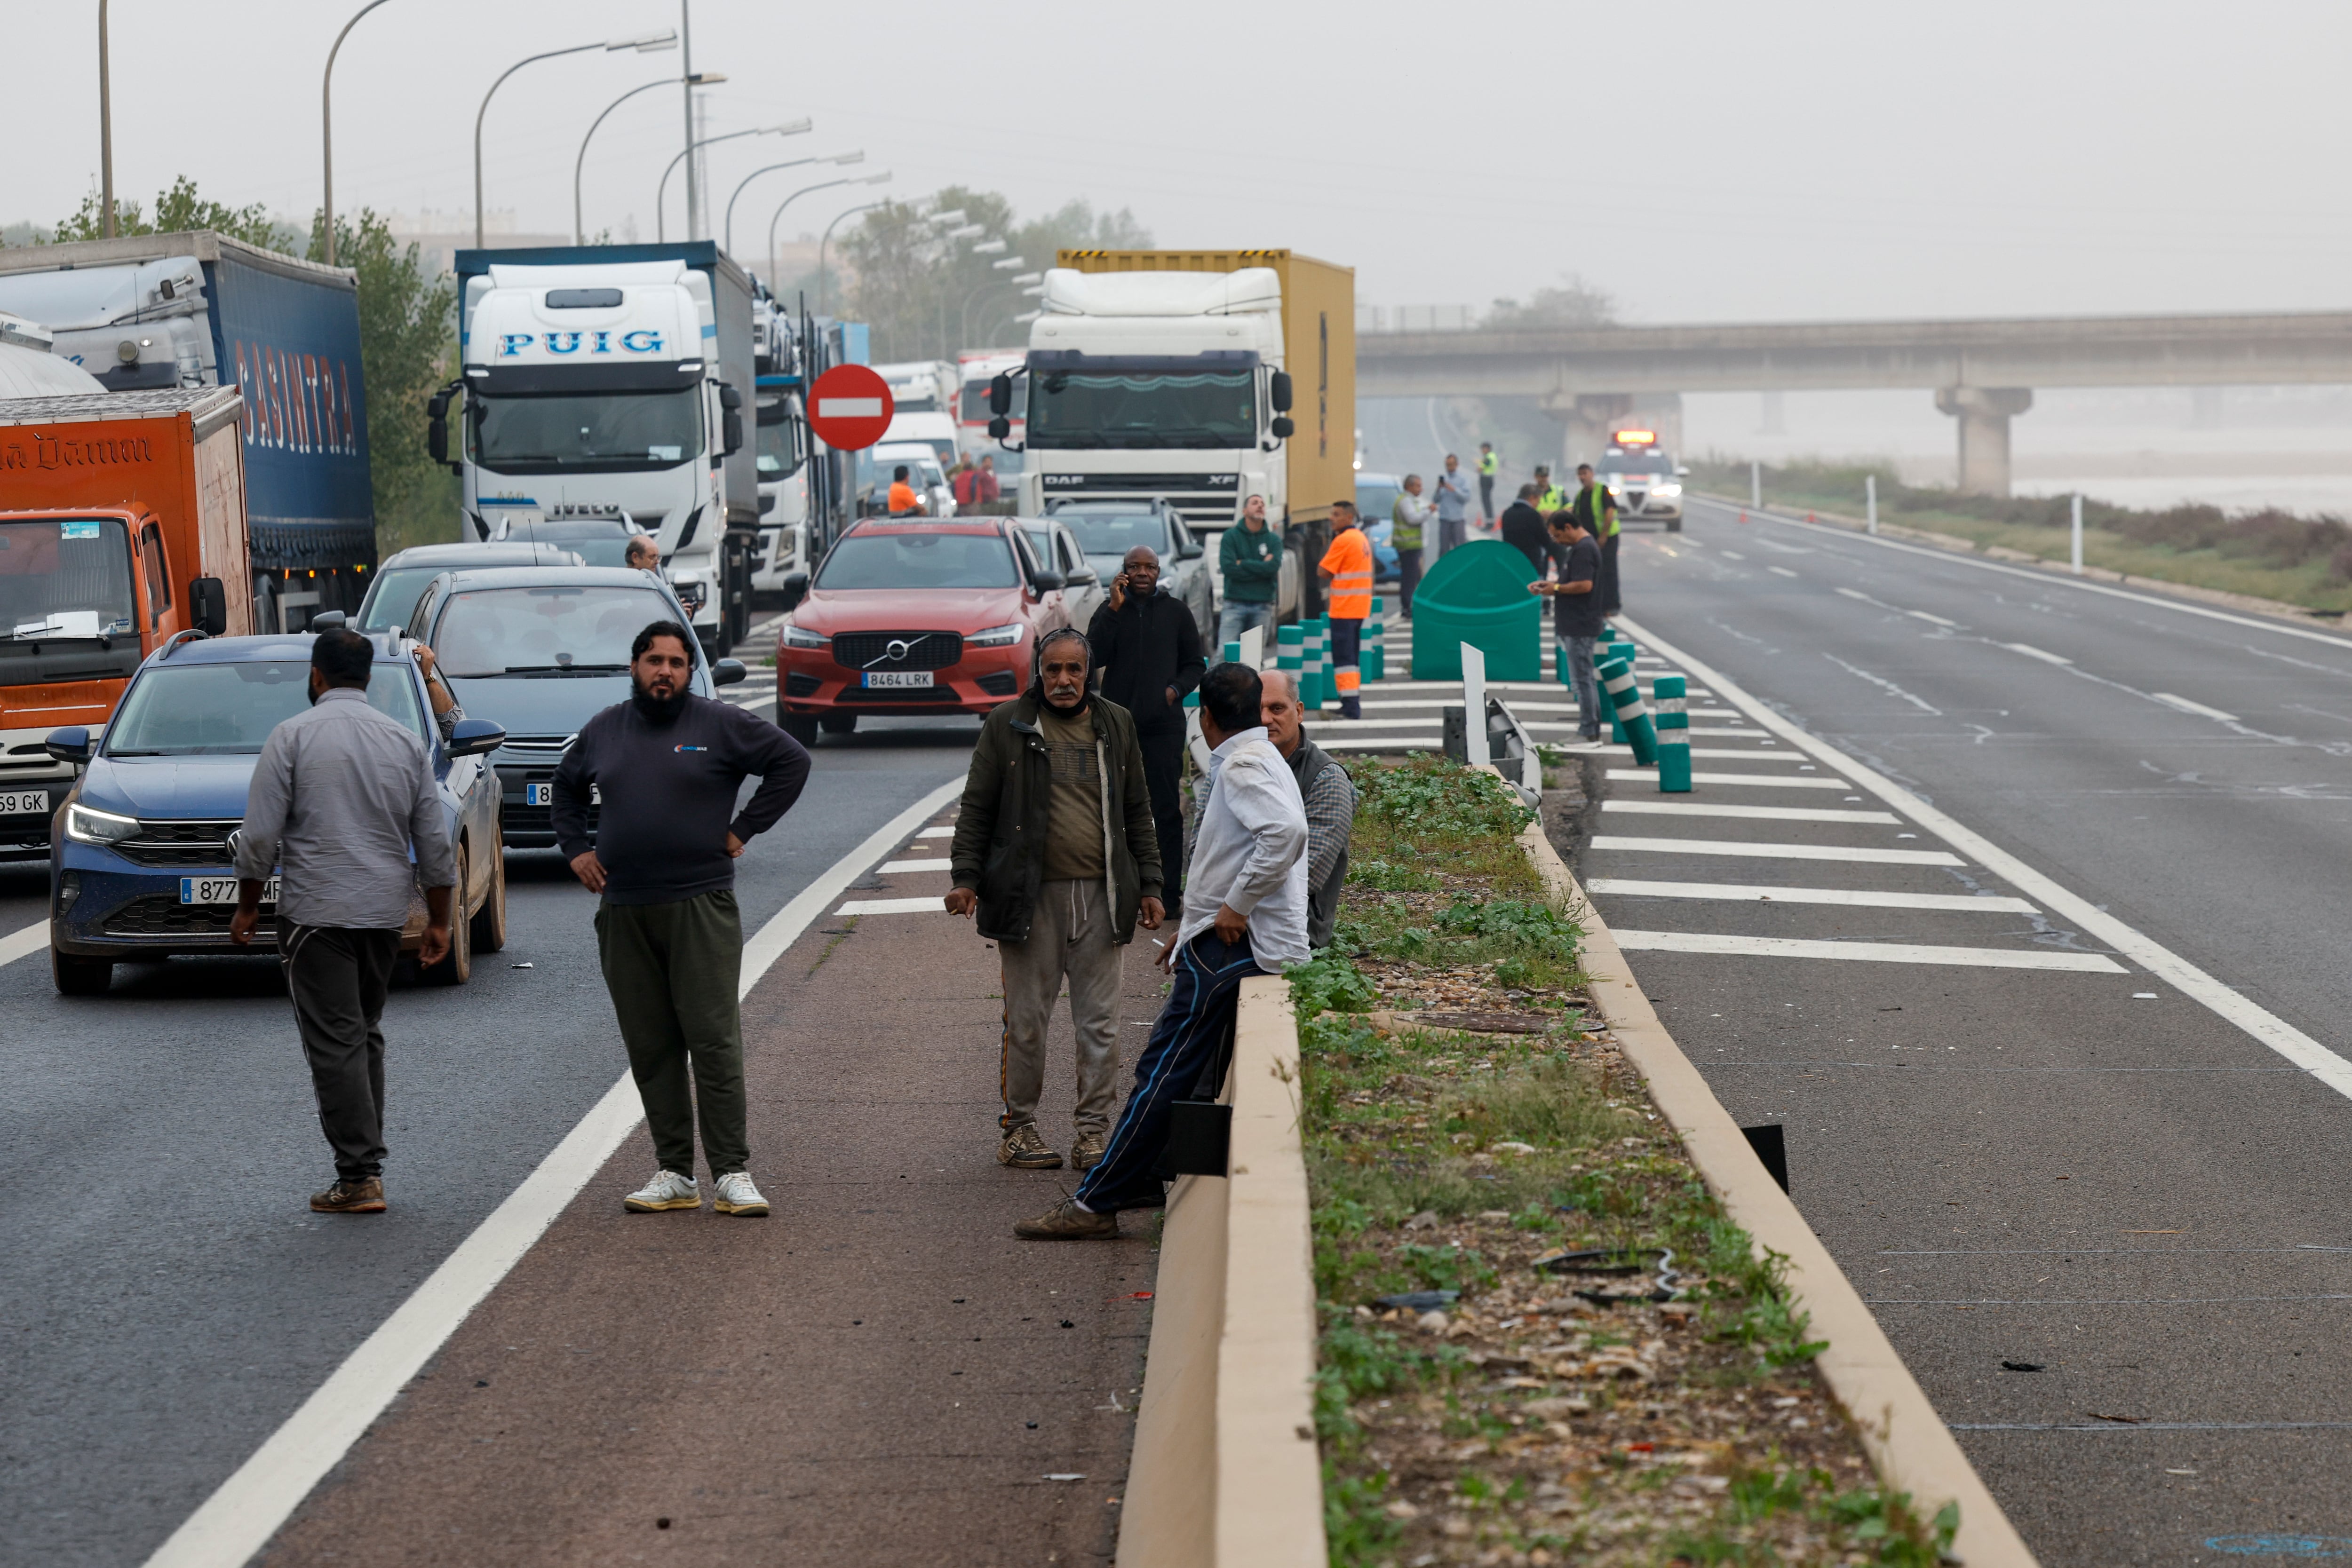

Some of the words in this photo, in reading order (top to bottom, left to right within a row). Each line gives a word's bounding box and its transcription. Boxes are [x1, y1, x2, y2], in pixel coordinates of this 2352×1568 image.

[500, 330, 665, 357] PUIG
[236, 339, 357, 456] CASINTRA
[33, 432, 152, 470] Damm
[1045, 475, 1084, 485] DAF
[1207, 475, 1238, 485] XF
[554, 500, 619, 515] IVECO
[871, 674, 901, 686] 8464
[906, 673, 929, 685] LRK
[23, 794, 43, 810] GK
[200, 881, 238, 900] 877
